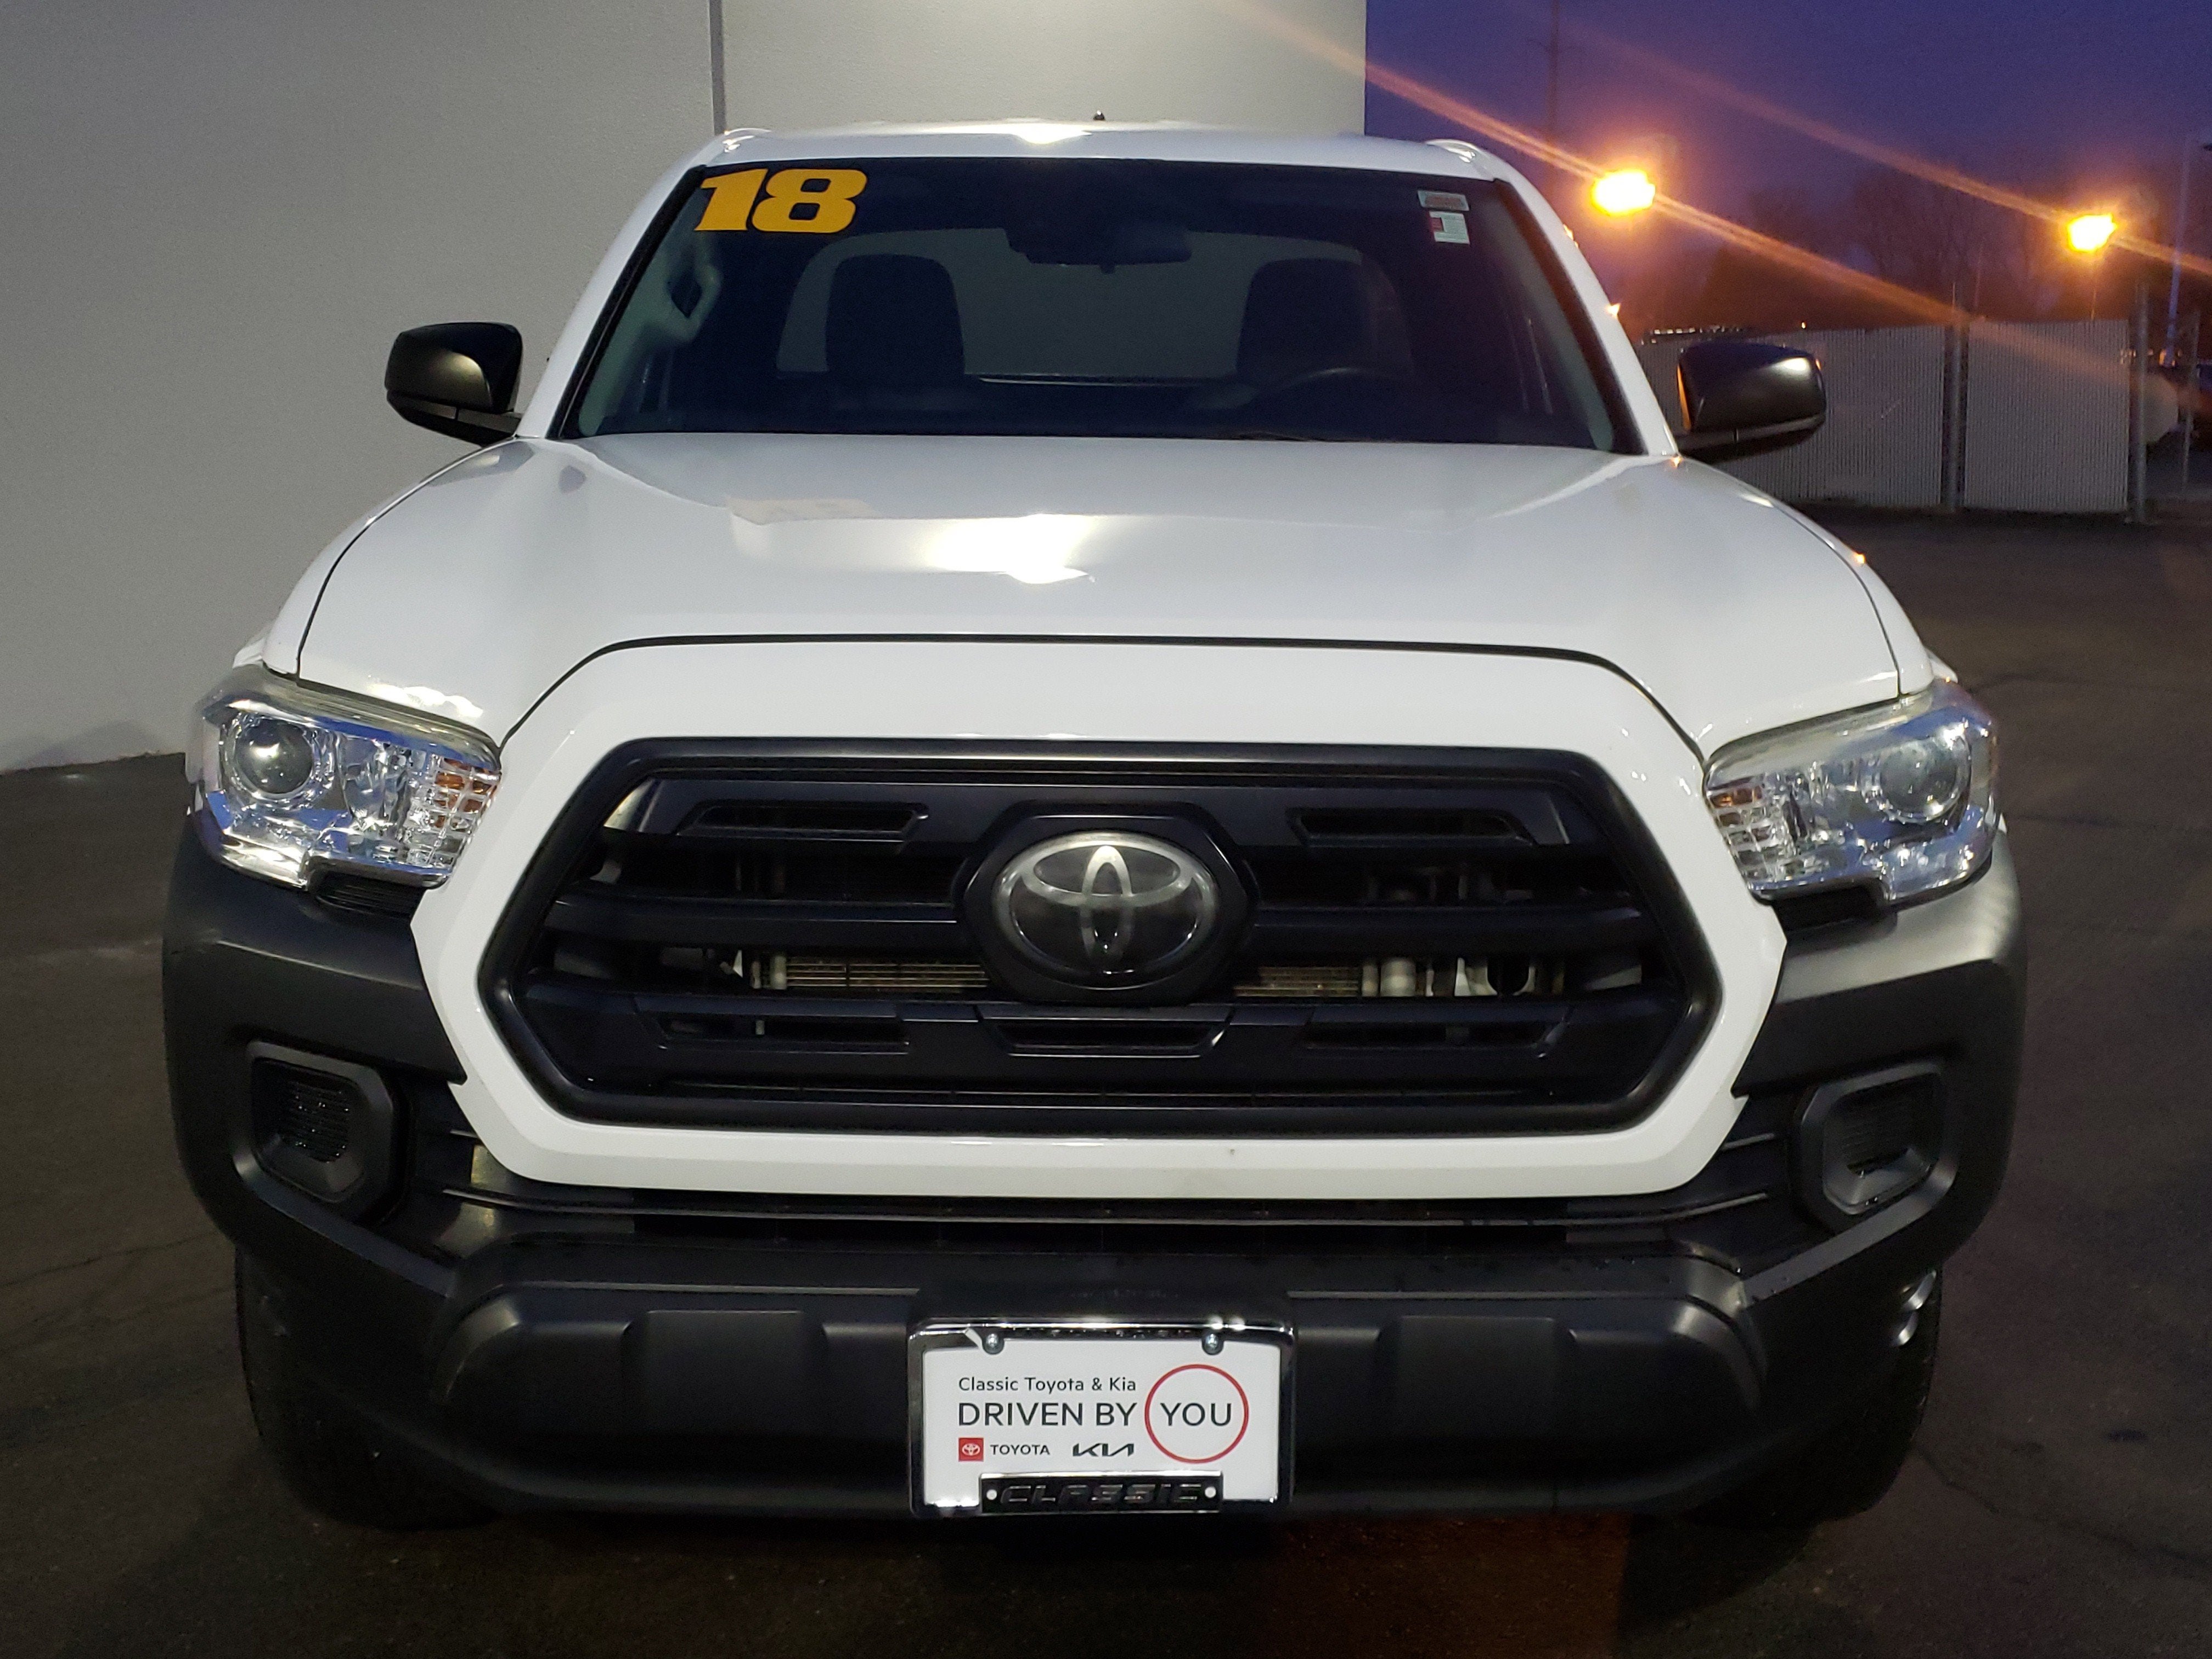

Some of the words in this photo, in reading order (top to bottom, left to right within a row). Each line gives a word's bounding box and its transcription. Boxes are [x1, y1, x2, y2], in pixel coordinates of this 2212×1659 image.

[695, 168, 867, 234] 18
[958, 1376, 1019, 1392] Classic
[1024, 1376, 1085, 1395] Toyota
[1091, 1377, 1103, 1392] &
[1109, 1376, 1137, 1392] Kia
[958, 1402, 1084, 1427] DRIVEN
[1095, 1402, 1138, 1427] BY
[1159, 1402, 1232, 1427] YOU
[990, 1443, 1051, 1456] TOYOTA
[1071, 1442, 1135, 1458] KIA
